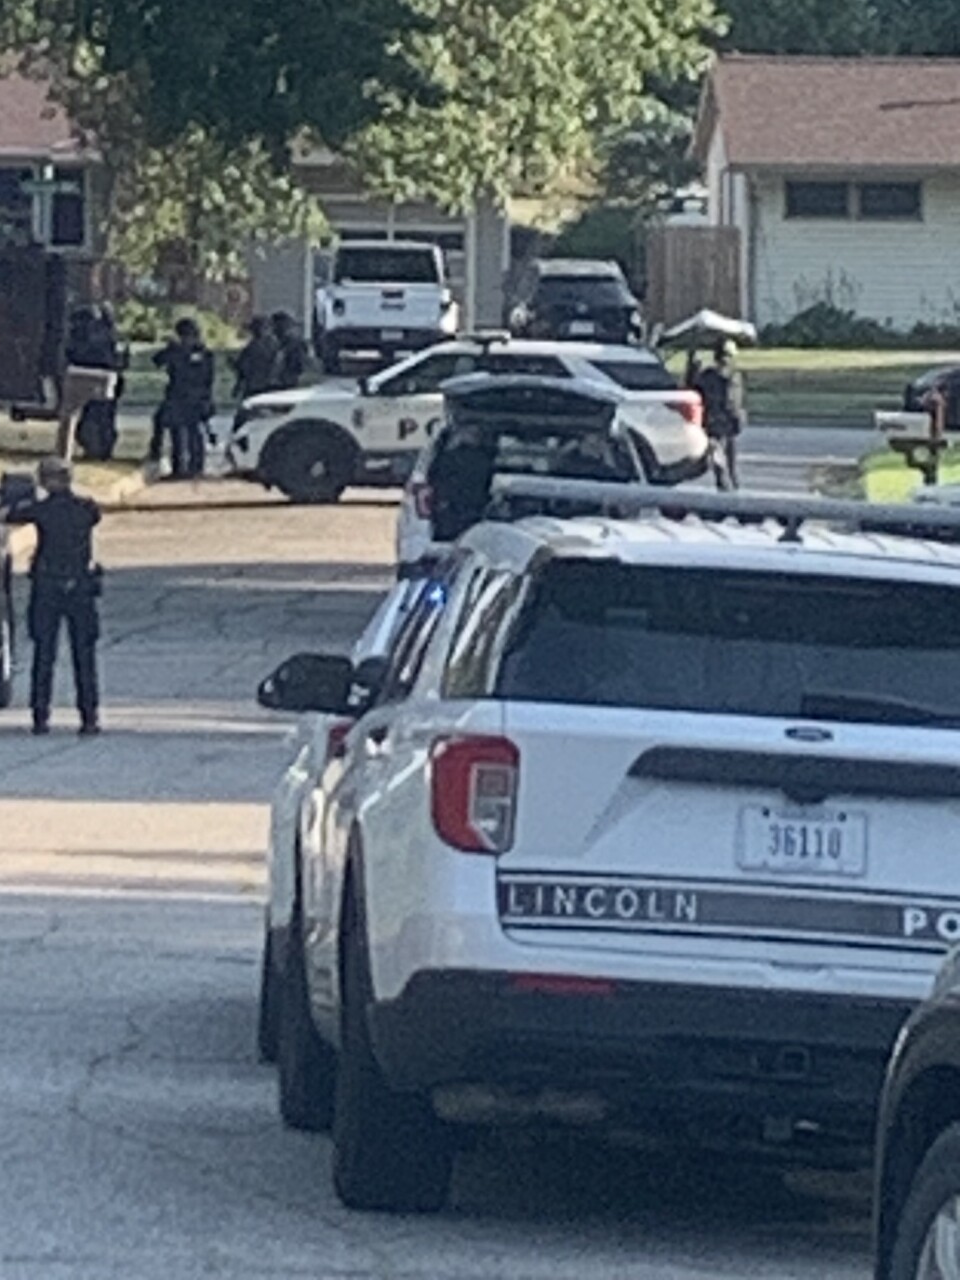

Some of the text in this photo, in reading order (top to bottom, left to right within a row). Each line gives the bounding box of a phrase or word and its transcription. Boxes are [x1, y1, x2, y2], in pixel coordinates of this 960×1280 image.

[768, 823, 842, 860] 36110
[508, 883, 960, 940] LINCOLN PO
